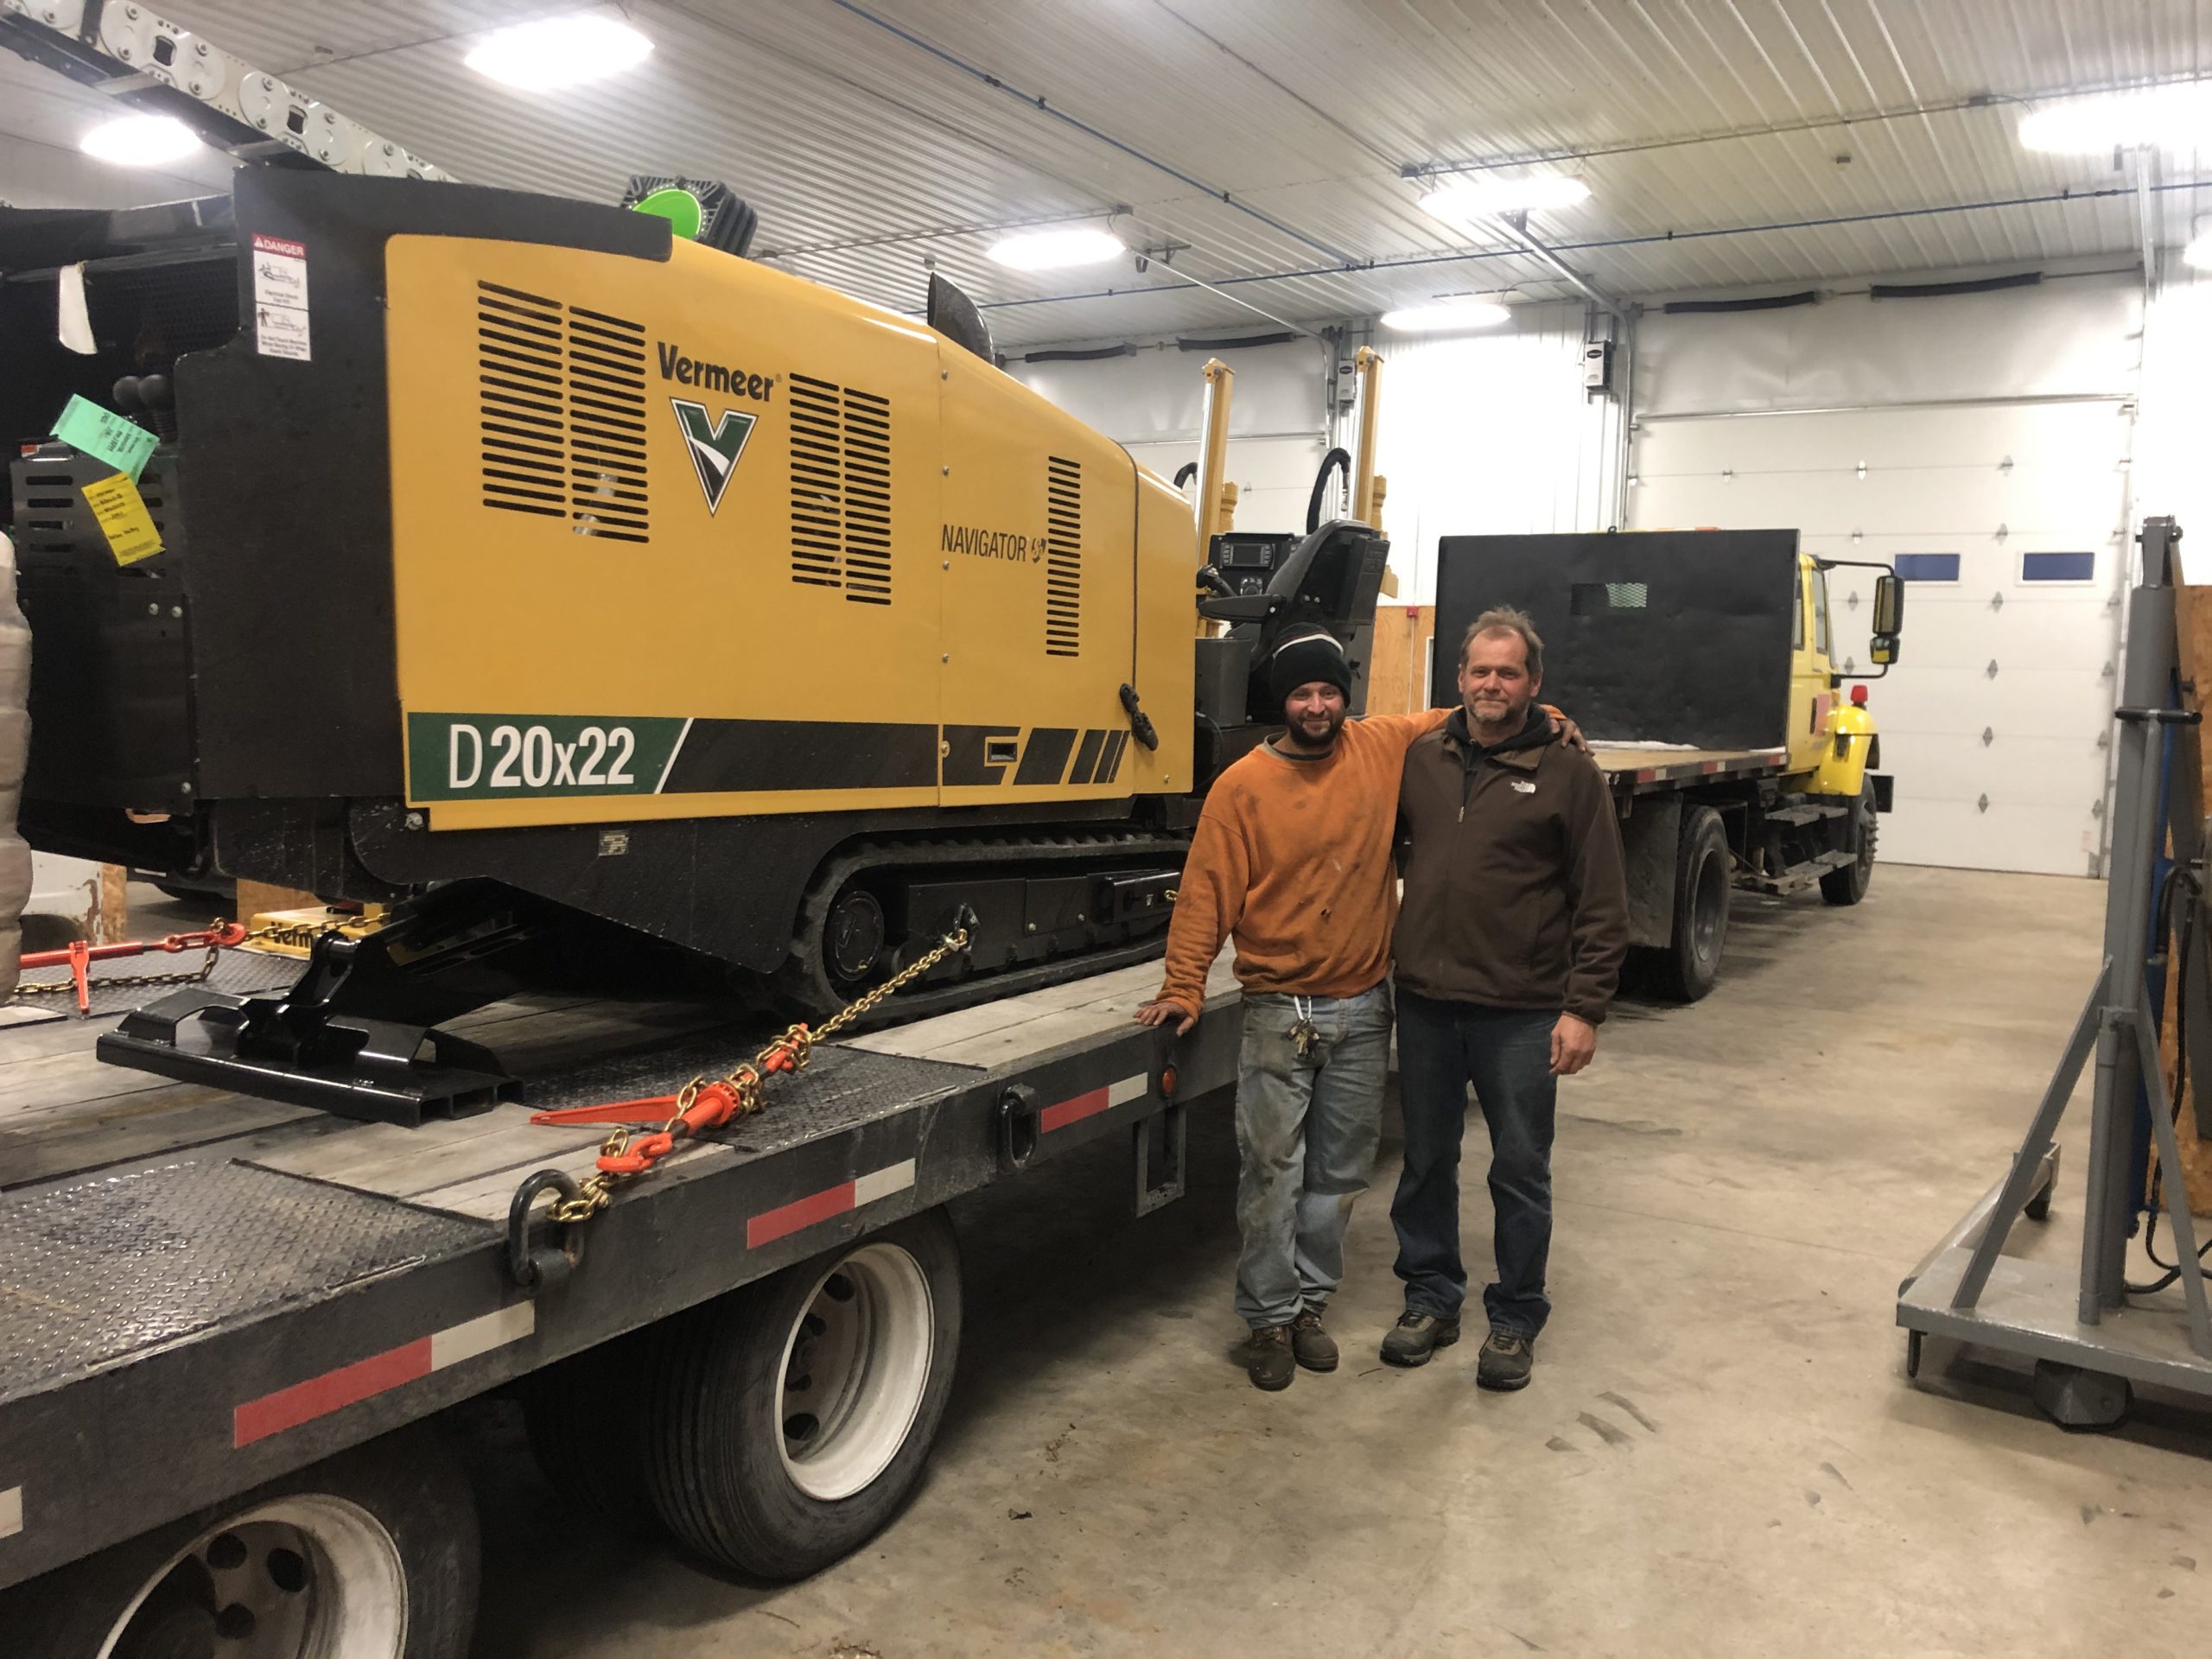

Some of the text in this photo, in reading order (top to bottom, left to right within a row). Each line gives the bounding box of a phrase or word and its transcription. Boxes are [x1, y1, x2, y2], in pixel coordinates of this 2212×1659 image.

[264, 239, 304, 256] DANGER
[658, 341, 774, 402] Vermeer
[941, 524, 1027, 563] NAVIGATOR
[270, 921, 314, 949] Verm
